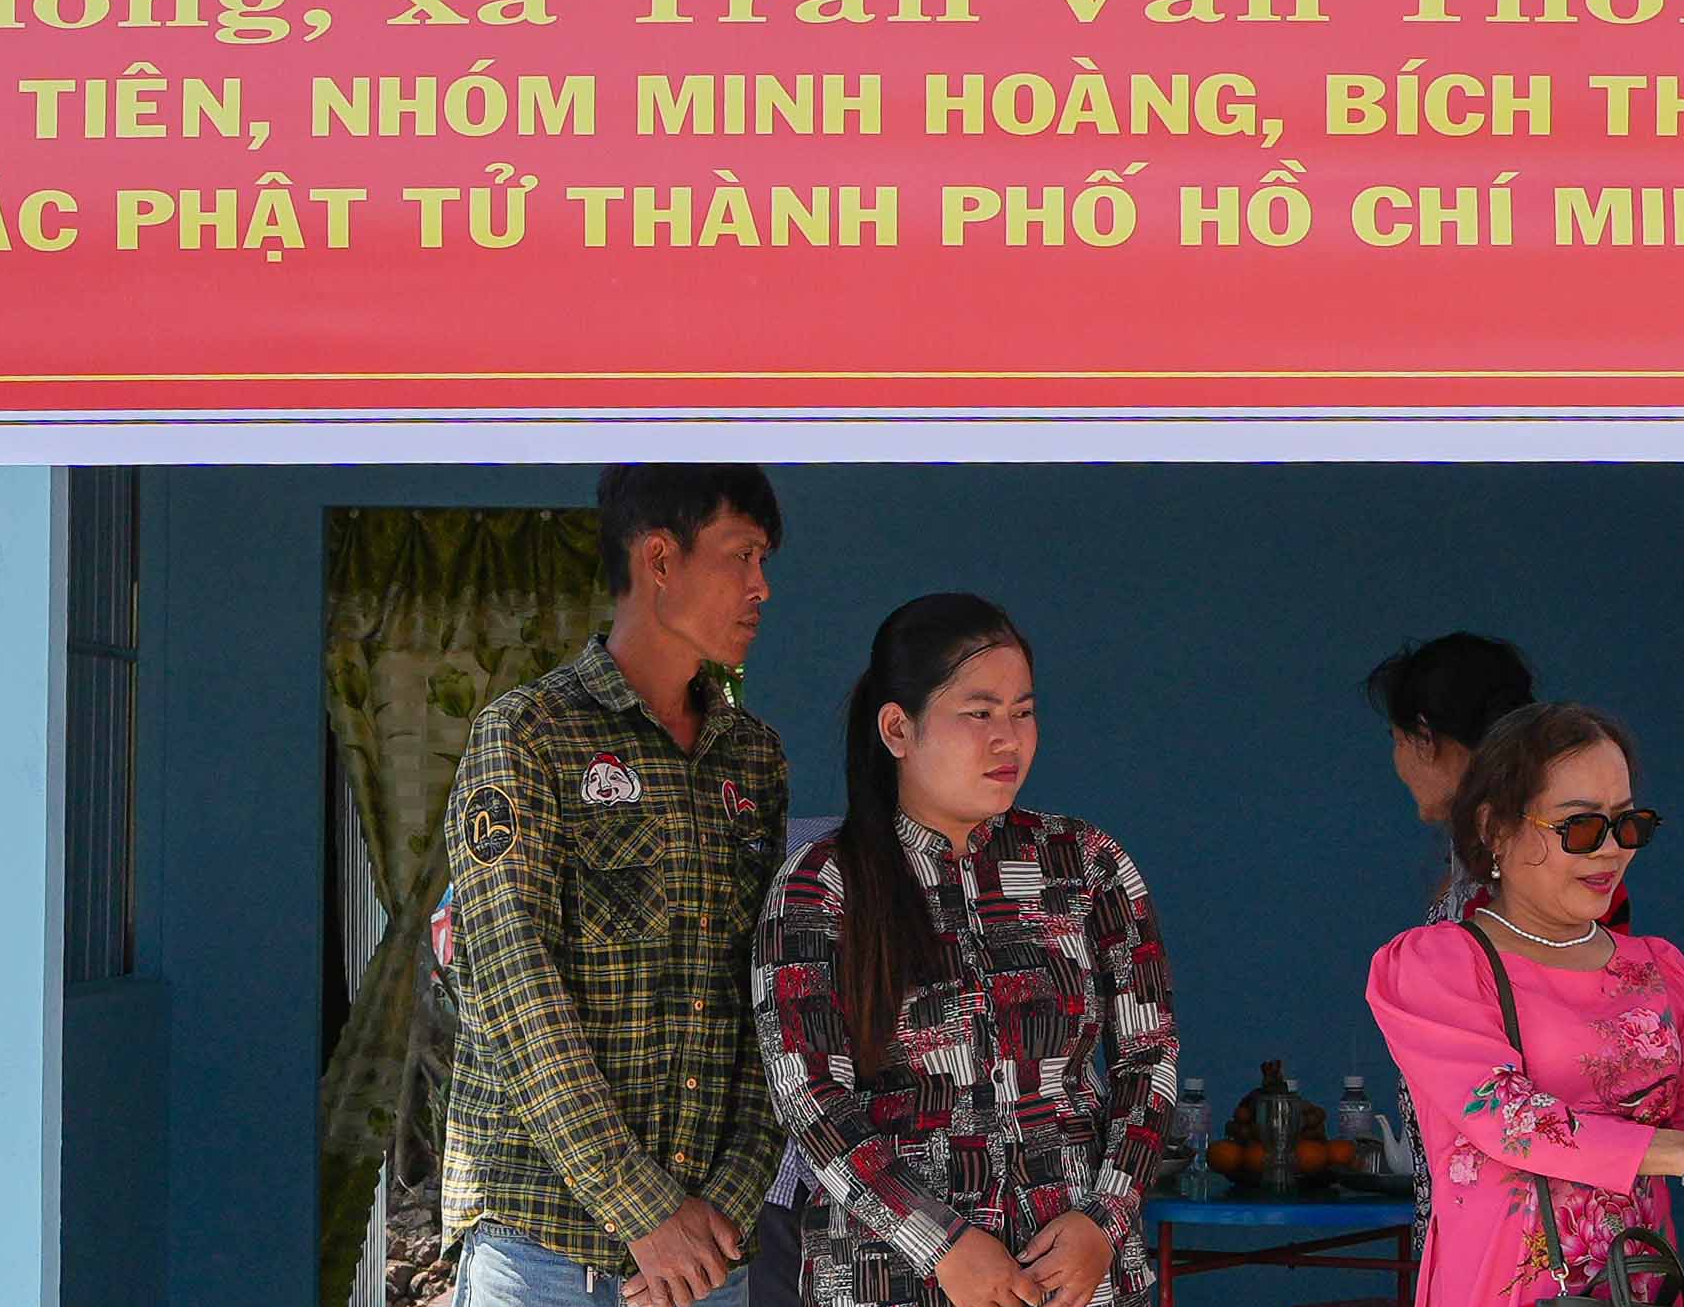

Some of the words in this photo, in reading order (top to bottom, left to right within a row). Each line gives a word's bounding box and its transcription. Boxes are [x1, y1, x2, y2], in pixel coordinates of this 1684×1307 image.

[19, 62, 270, 149] TIÊN,
[314, 58, 596, 137] NHÓM
[637, 74, 882, 135] MINH
[925, 56, 1284, 149] HOÀNG,
[1327, 58, 1552, 137] BÍCH
[116, 171, 368, 262] PHẬT
[403, 162, 539, 249] TỬ
[566, 169, 898, 247] THÀNH
[942, 162, 1148, 247] PHỐ
[1181, 159, 1312, 247] HỒ
[1352, 171, 1516, 247] CHÍ
